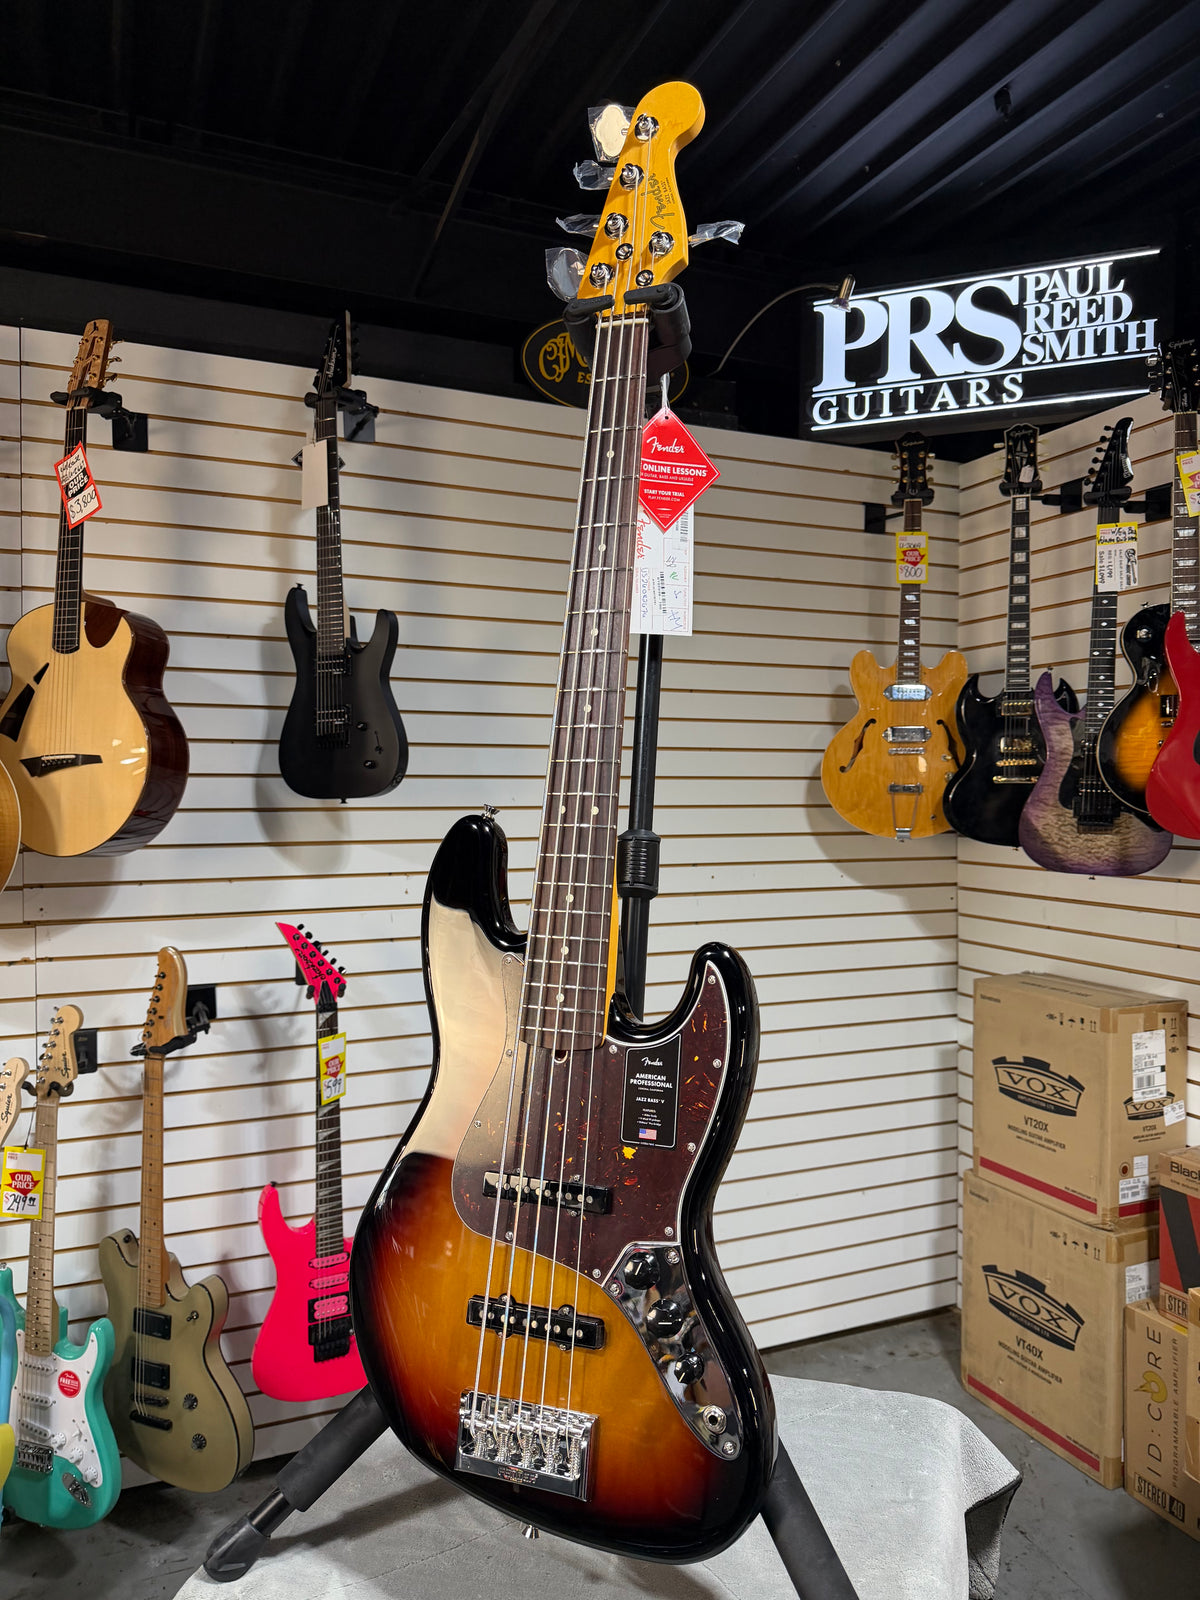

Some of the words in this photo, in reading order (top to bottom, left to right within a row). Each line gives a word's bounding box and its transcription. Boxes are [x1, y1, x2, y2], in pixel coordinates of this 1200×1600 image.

[1022, 262, 1127, 305] PAUL
[1022, 293, 1133, 335] REED
[812, 274, 1024, 393] PRS
[1022, 318, 1159, 366] SMITH
[812, 373, 1024, 425] GUITARS
[646, 436, 685, 454] Fender
[69, 473, 84, 489] OUR
[643, 463, 671, 474] ONLINE
[672, 466, 706, 477] LESSONS
[68, 475, 89, 498] PRICE
[636, 509, 652, 560] Fender
[61, 1051, 72, 1079] Squier
[641, 1056, 663, 1066] Fender
[629, 1079, 673, 1088] PROFESSIONAL
[635, 1073, 667, 1081] AMERICAN
[1002, 1069, 1070, 1103] VOX
[1, 1093, 12, 1124] Squier
[1131, 1099, 1167, 1112] VOX
[1023, 1114, 1049, 1133] VT20X
[11, 1180, 35, 1190] PRICE
[14, 1173, 32, 1182] OUR
[992, 1279, 1068, 1334] VOX
[1167, 1295, 1188, 1318] STER
[1016, 1335, 1044, 1361] VT40X
[1137, 1476, 1167, 1511] STEREO
[1172, 1502, 1185, 1520] 40
